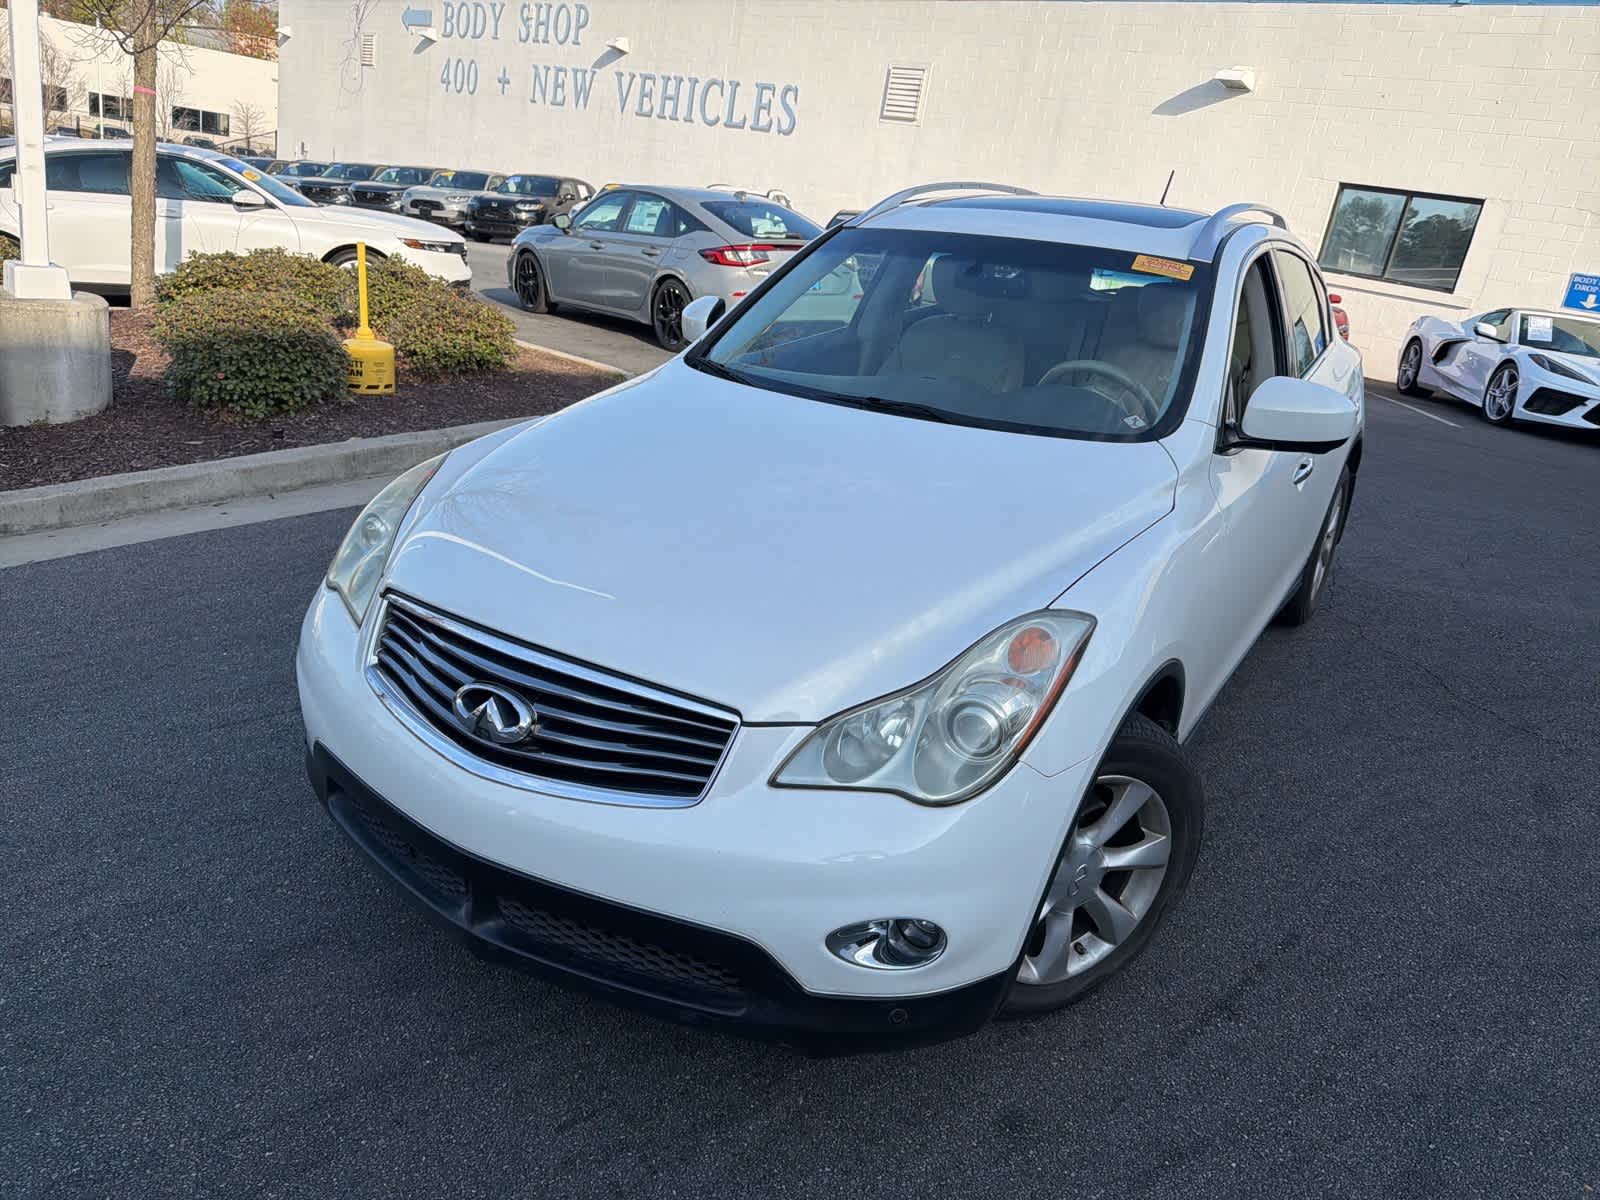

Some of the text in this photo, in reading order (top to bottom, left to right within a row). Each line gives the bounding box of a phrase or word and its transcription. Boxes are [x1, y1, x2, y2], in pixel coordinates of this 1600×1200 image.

[441, 1, 590, 45] BODY SHOP
[440, 57, 799, 136] 400 + NEW VEHICLES
